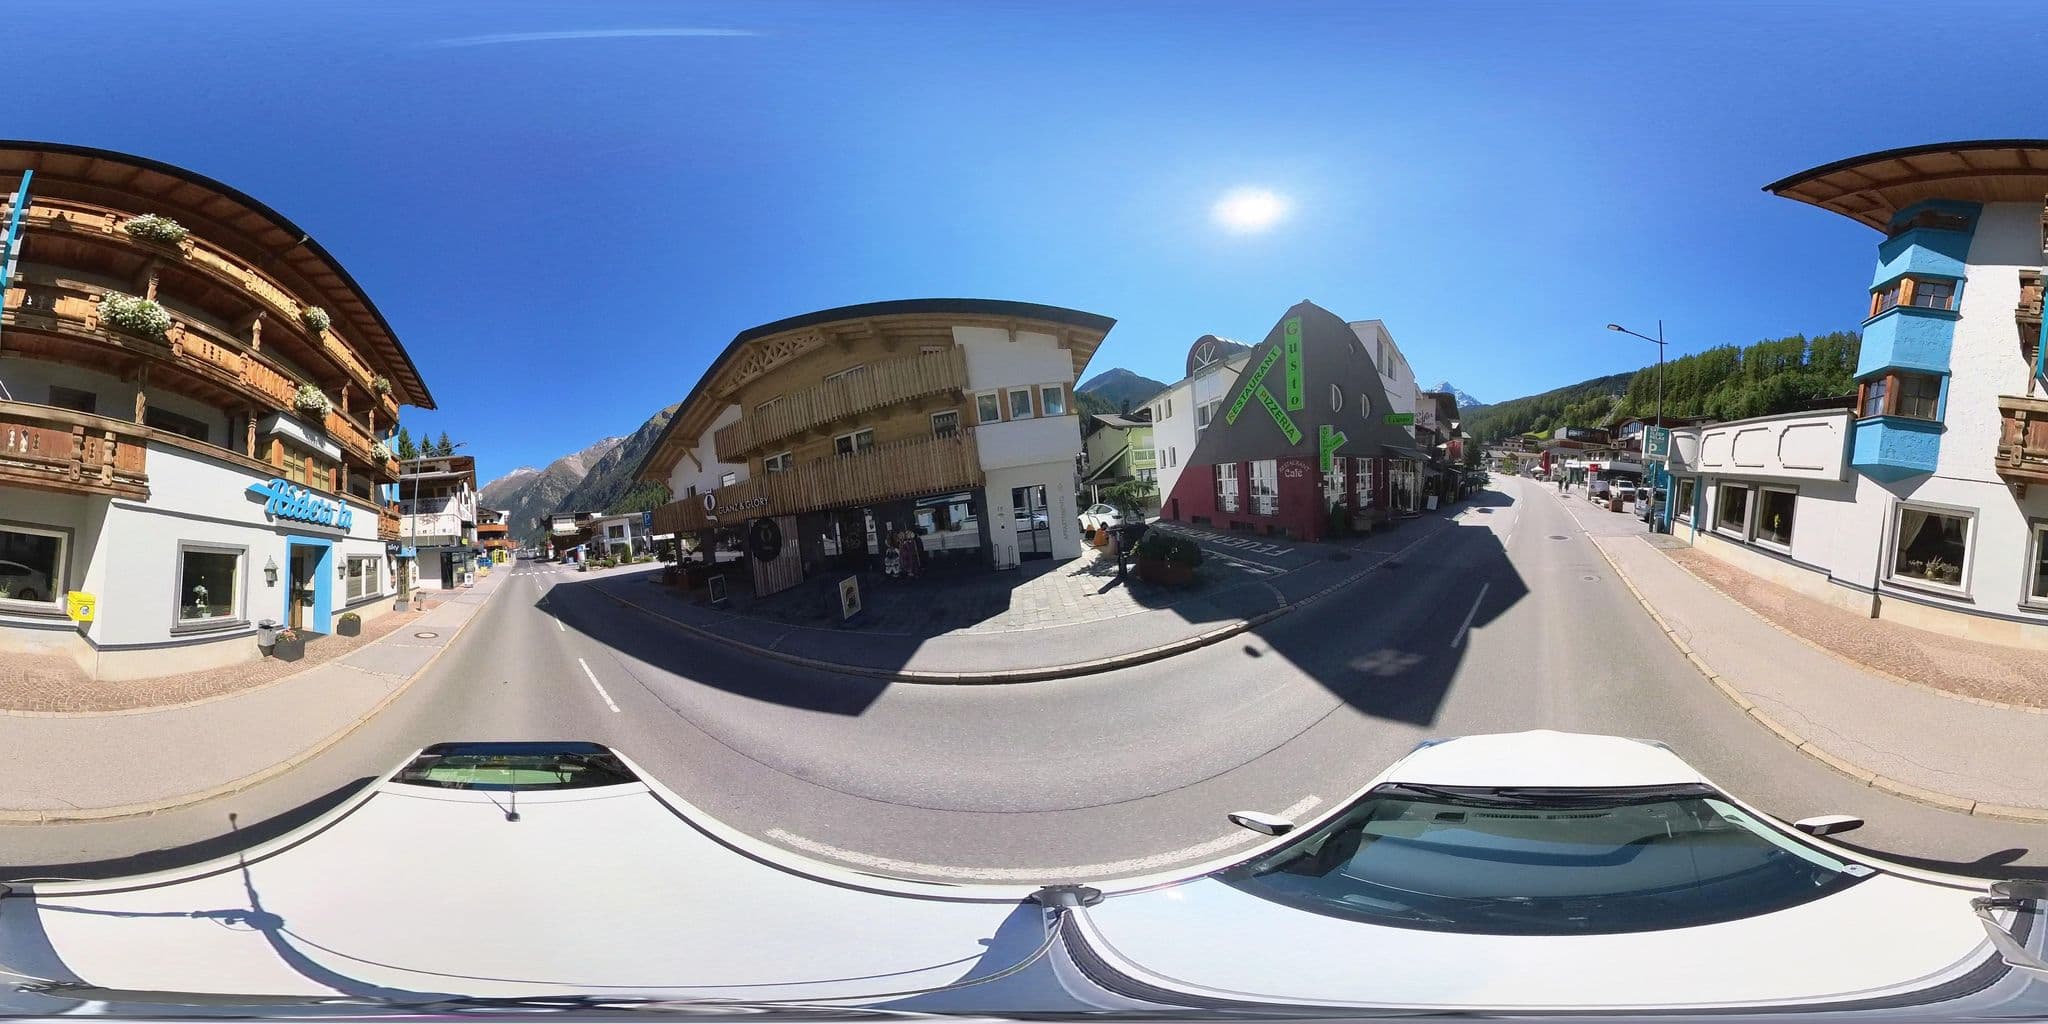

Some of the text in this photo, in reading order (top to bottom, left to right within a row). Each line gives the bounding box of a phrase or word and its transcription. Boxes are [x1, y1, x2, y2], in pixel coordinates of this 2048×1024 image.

[1287, 322, 1299, 405] Gusto
[1228, 348, 1278, 420] RESTAURANT
[1260, 390, 1295, 438] PIZZERIA
[1648, 443, 1657, 455] P
[247, 478, 333, 523] Riders
[720, 503, 740, 514] GLANZ
[745, 496, 768, 508] GLORY
[644, 513, 650, 525] P
[388, 543, 400, 552] sky
